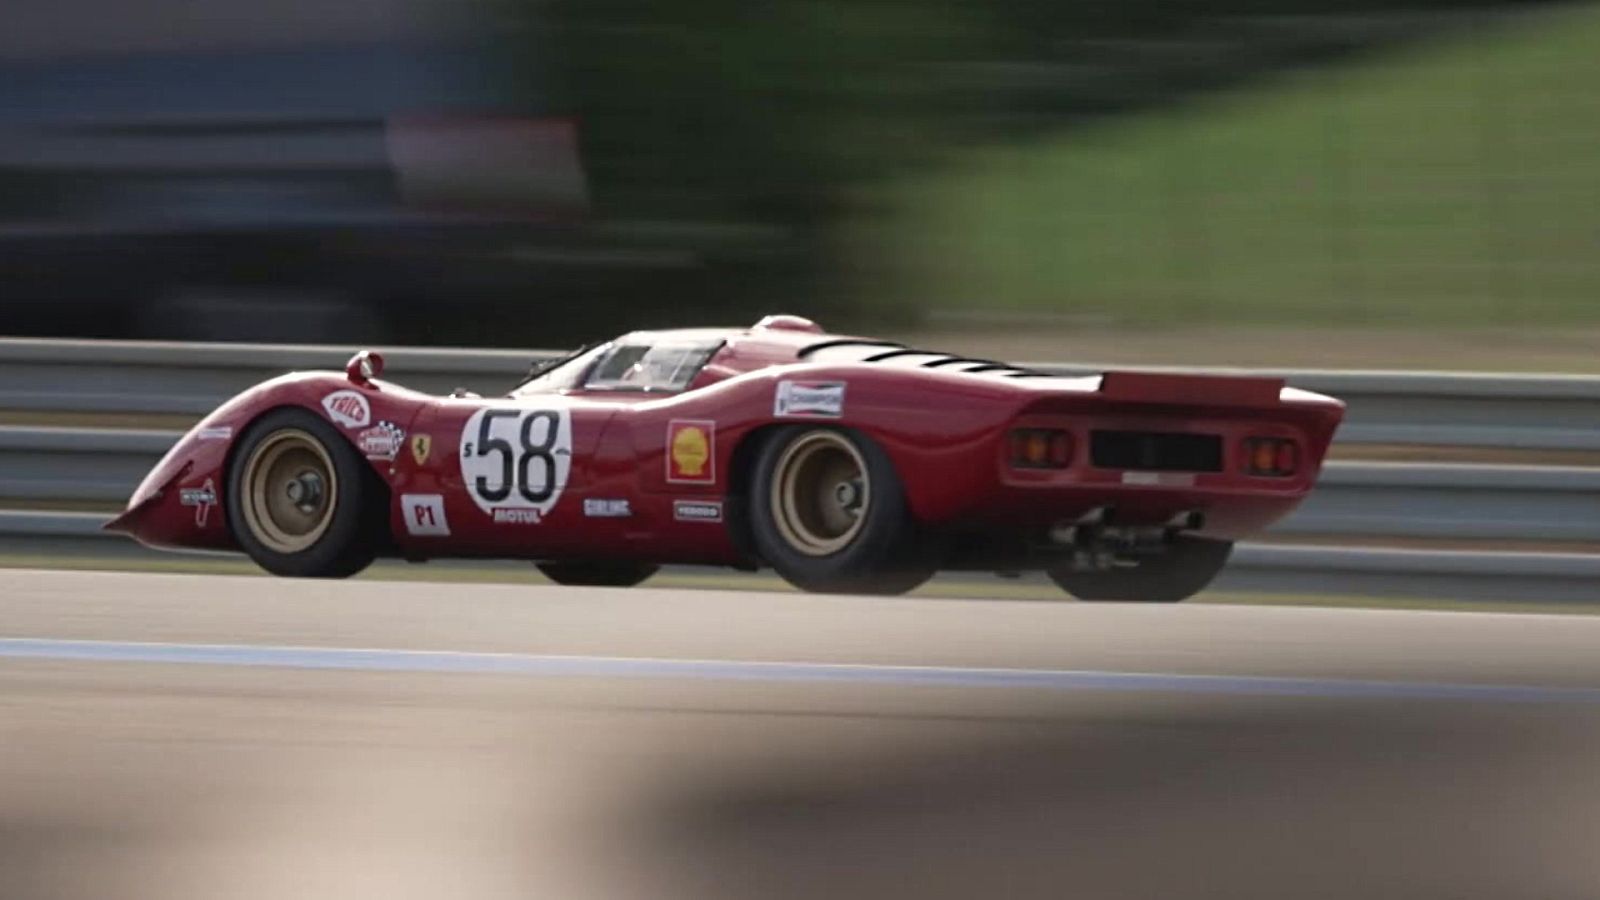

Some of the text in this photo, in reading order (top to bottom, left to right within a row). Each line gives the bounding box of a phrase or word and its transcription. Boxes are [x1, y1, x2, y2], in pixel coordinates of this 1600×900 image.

[475, 408, 560, 503] 58
[413, 504, 436, 526] P1
[493, 508, 541, 524] MOTUL
